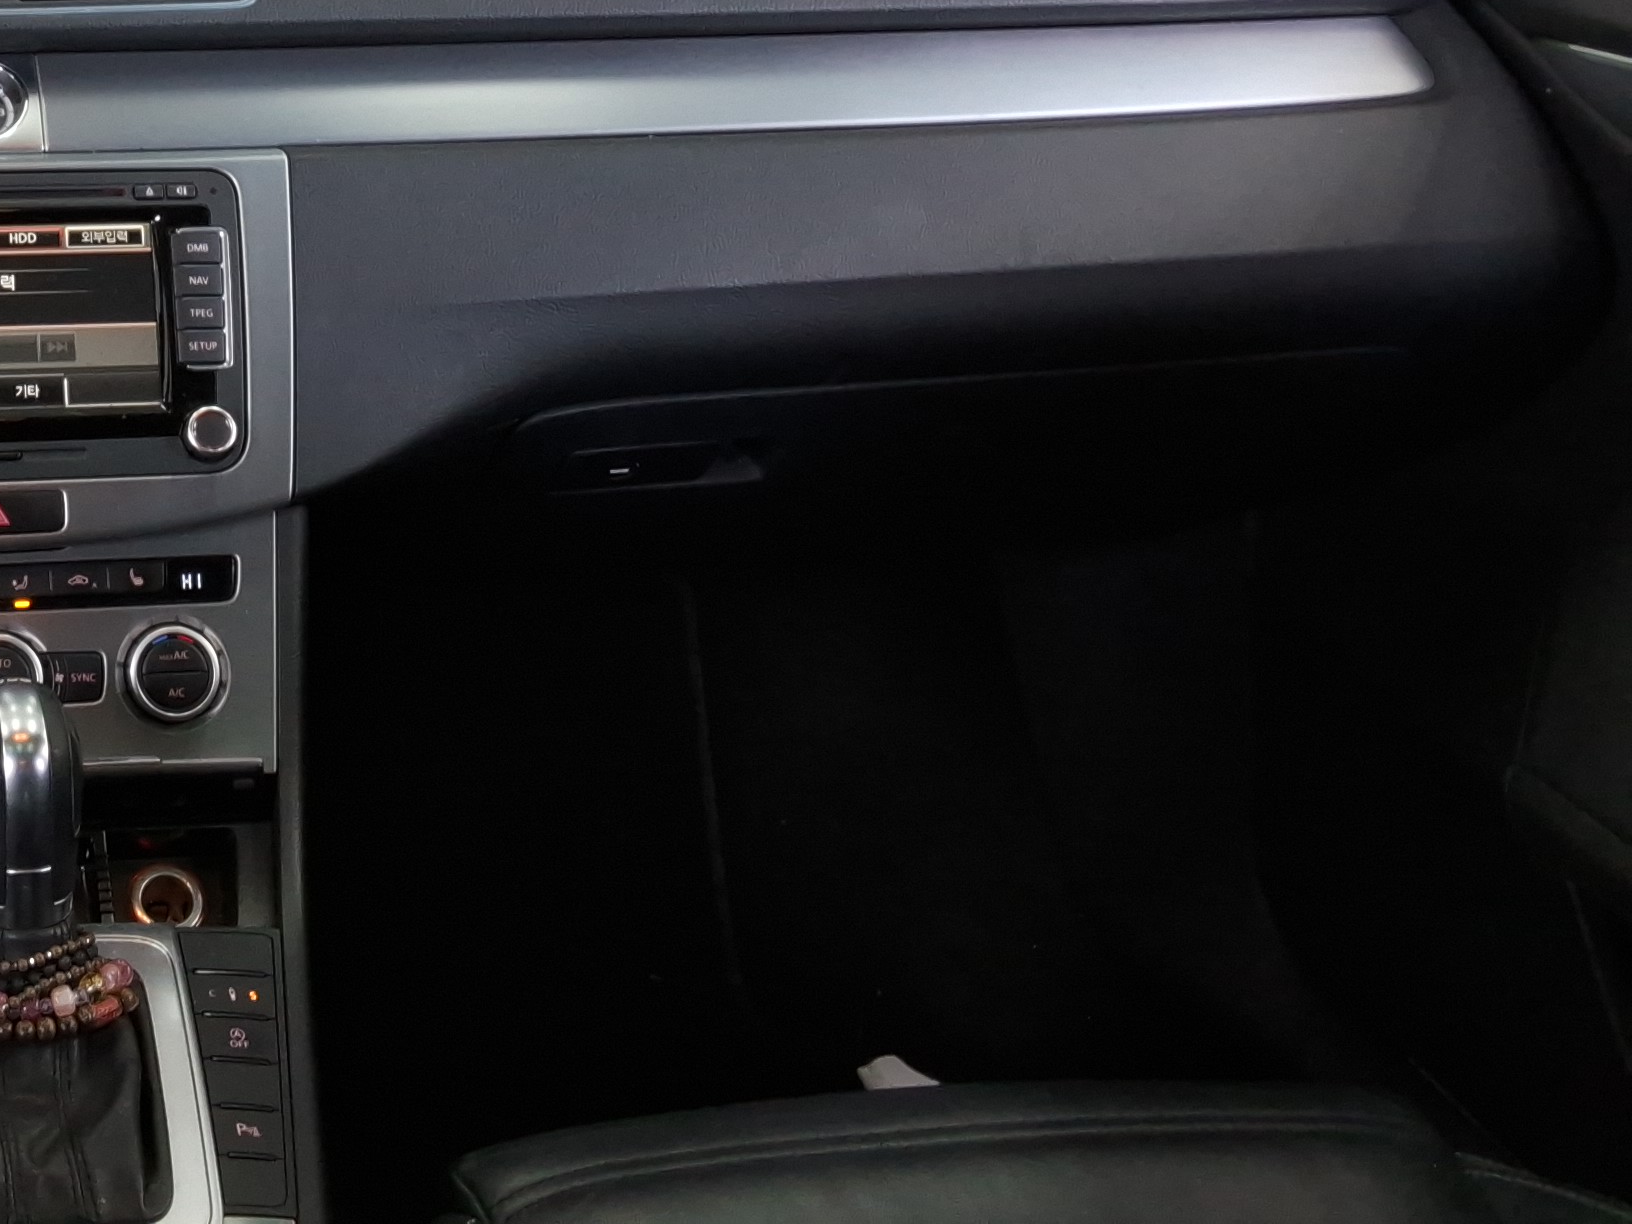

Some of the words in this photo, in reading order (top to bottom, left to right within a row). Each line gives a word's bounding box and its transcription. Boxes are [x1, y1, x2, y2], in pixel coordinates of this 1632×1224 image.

[9, 232, 37, 244] HDD
[81, 230, 128, 243] 외부입력
[187, 243, 209, 252] DMB
[189, 276, 209, 285] NAV
[190, 308, 214, 318] TPEG
[188, 341, 218, 351] SETUP
[15, 383, 40, 399] 기타
[173, 650, 190, 661] A/C
[71, 673, 97, 683] SYNC
[168, 687, 186, 697] A/C
[230, 1040, 249, 1049] OFF
